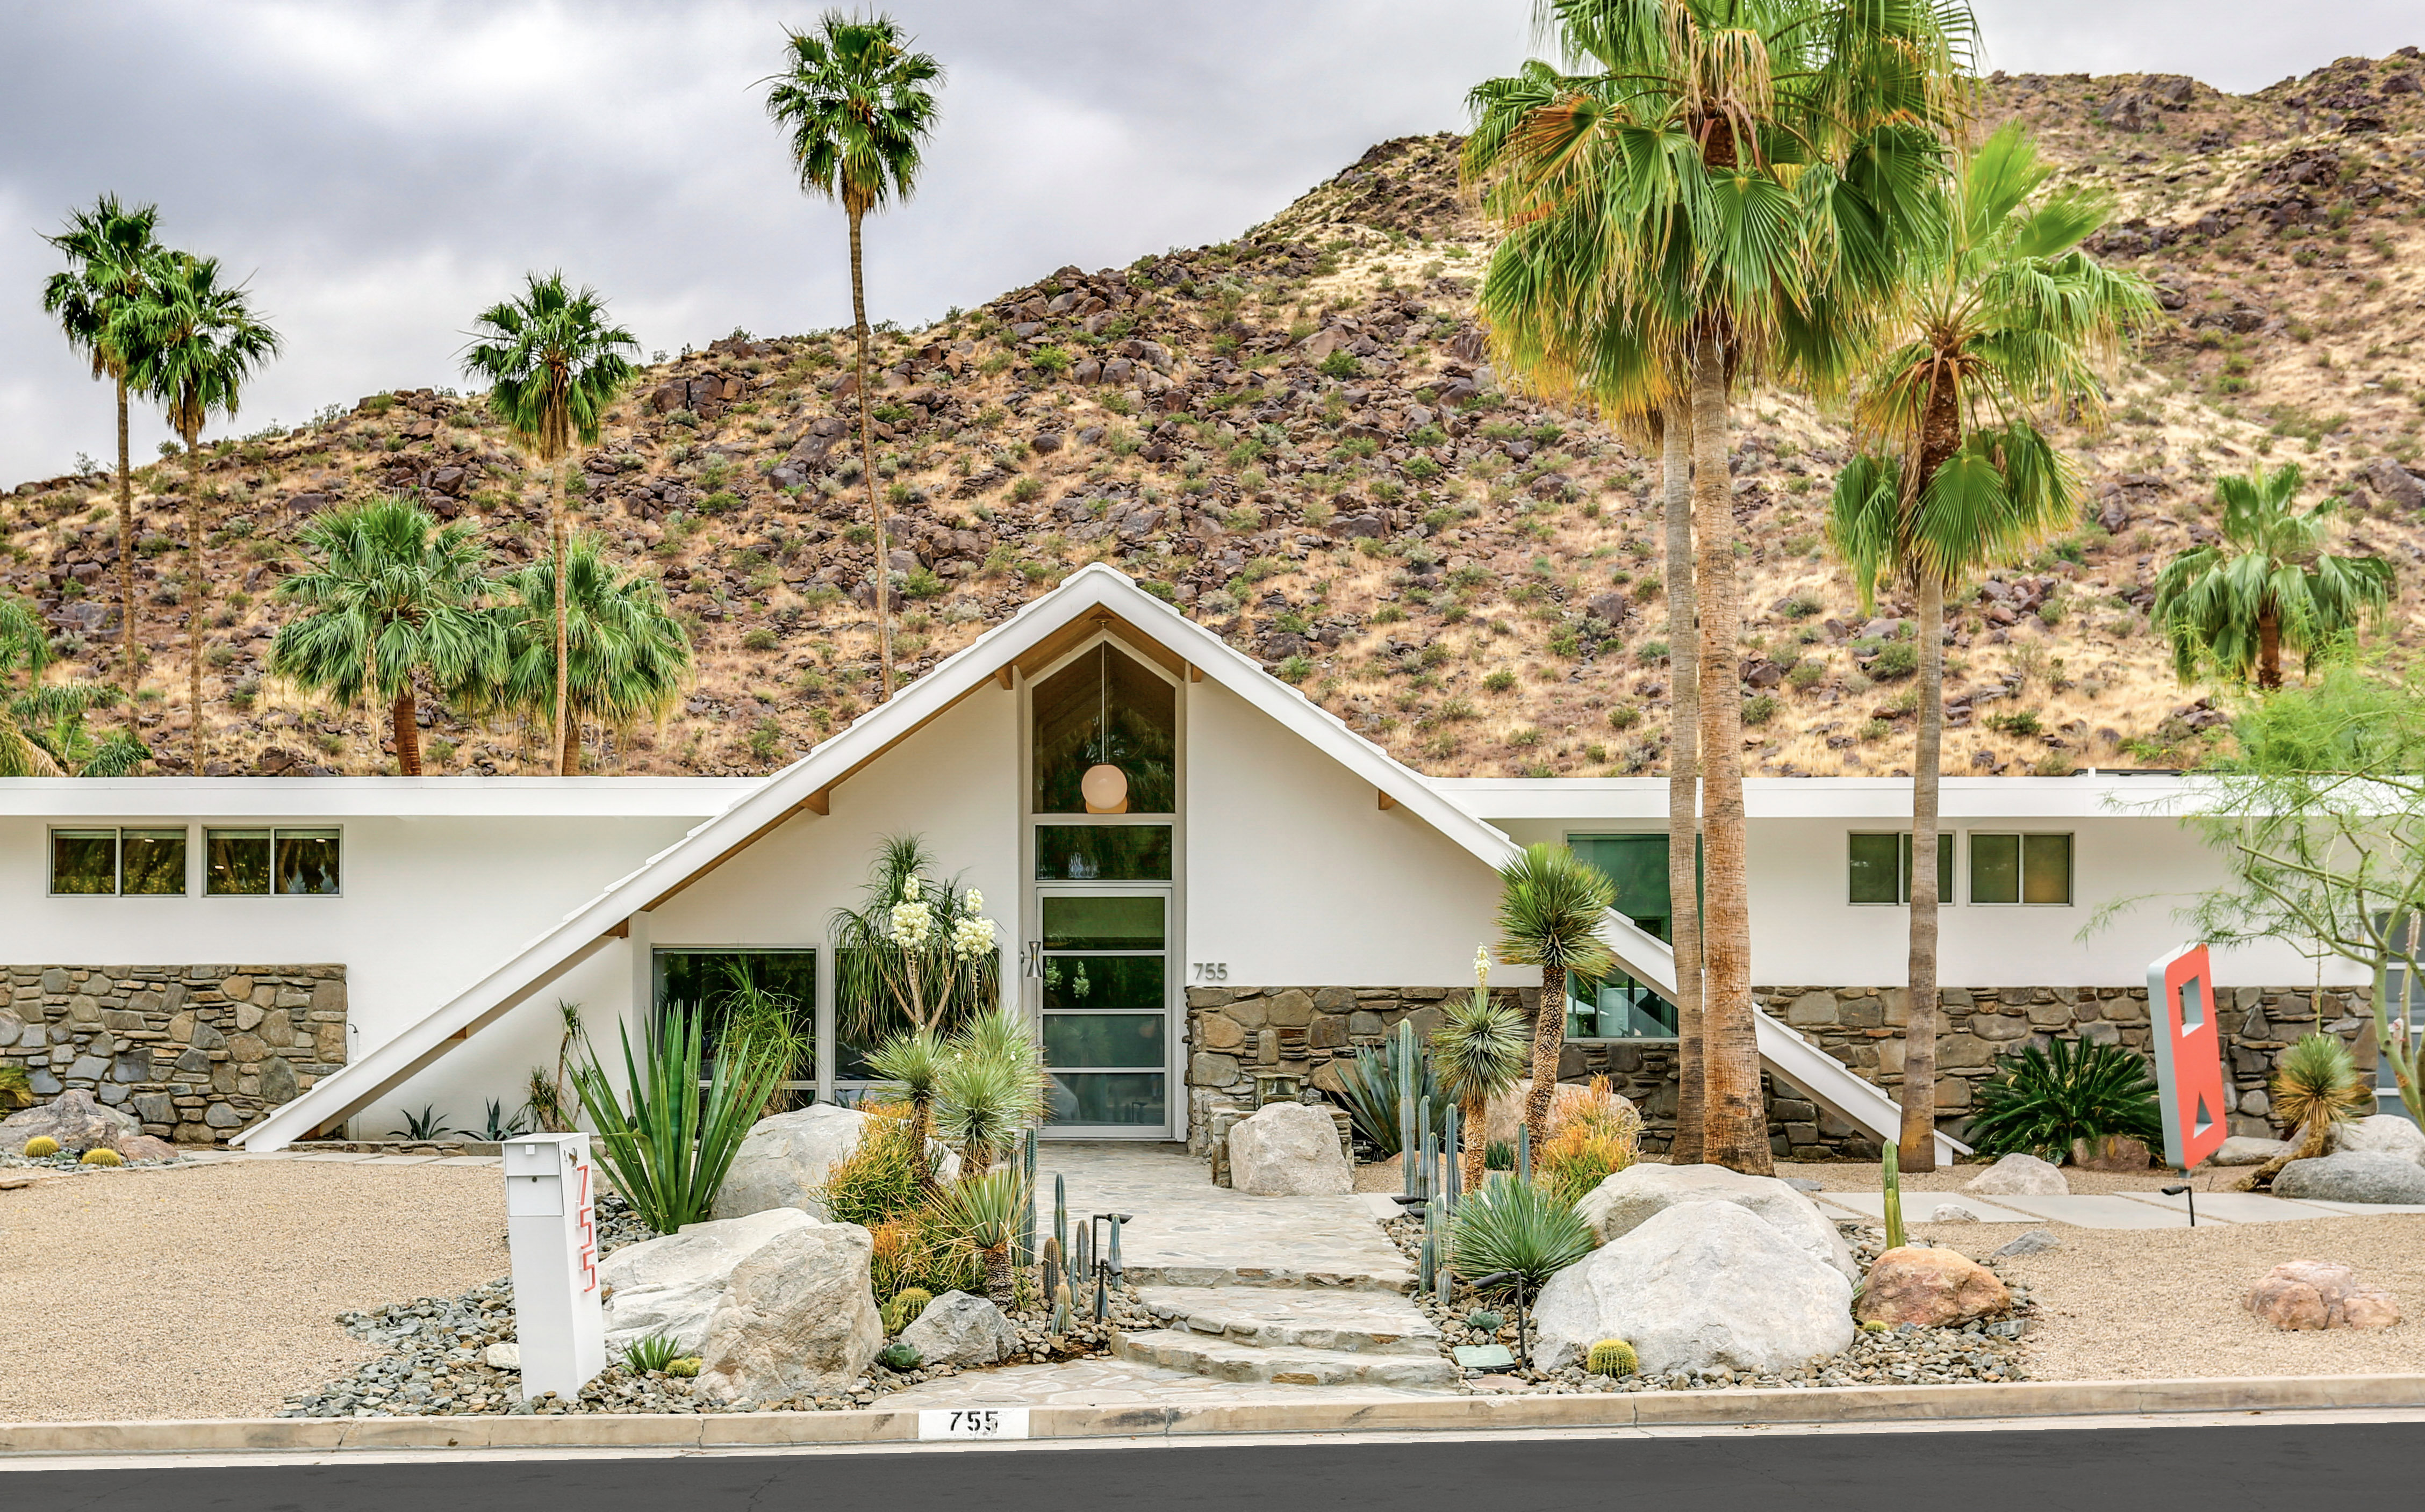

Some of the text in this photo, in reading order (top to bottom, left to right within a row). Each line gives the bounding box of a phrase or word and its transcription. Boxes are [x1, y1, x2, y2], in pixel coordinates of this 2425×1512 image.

[1193, 962, 1228, 980] 755
[577, 1164, 596, 1293] 755
[950, 1410, 999, 1432] 755
